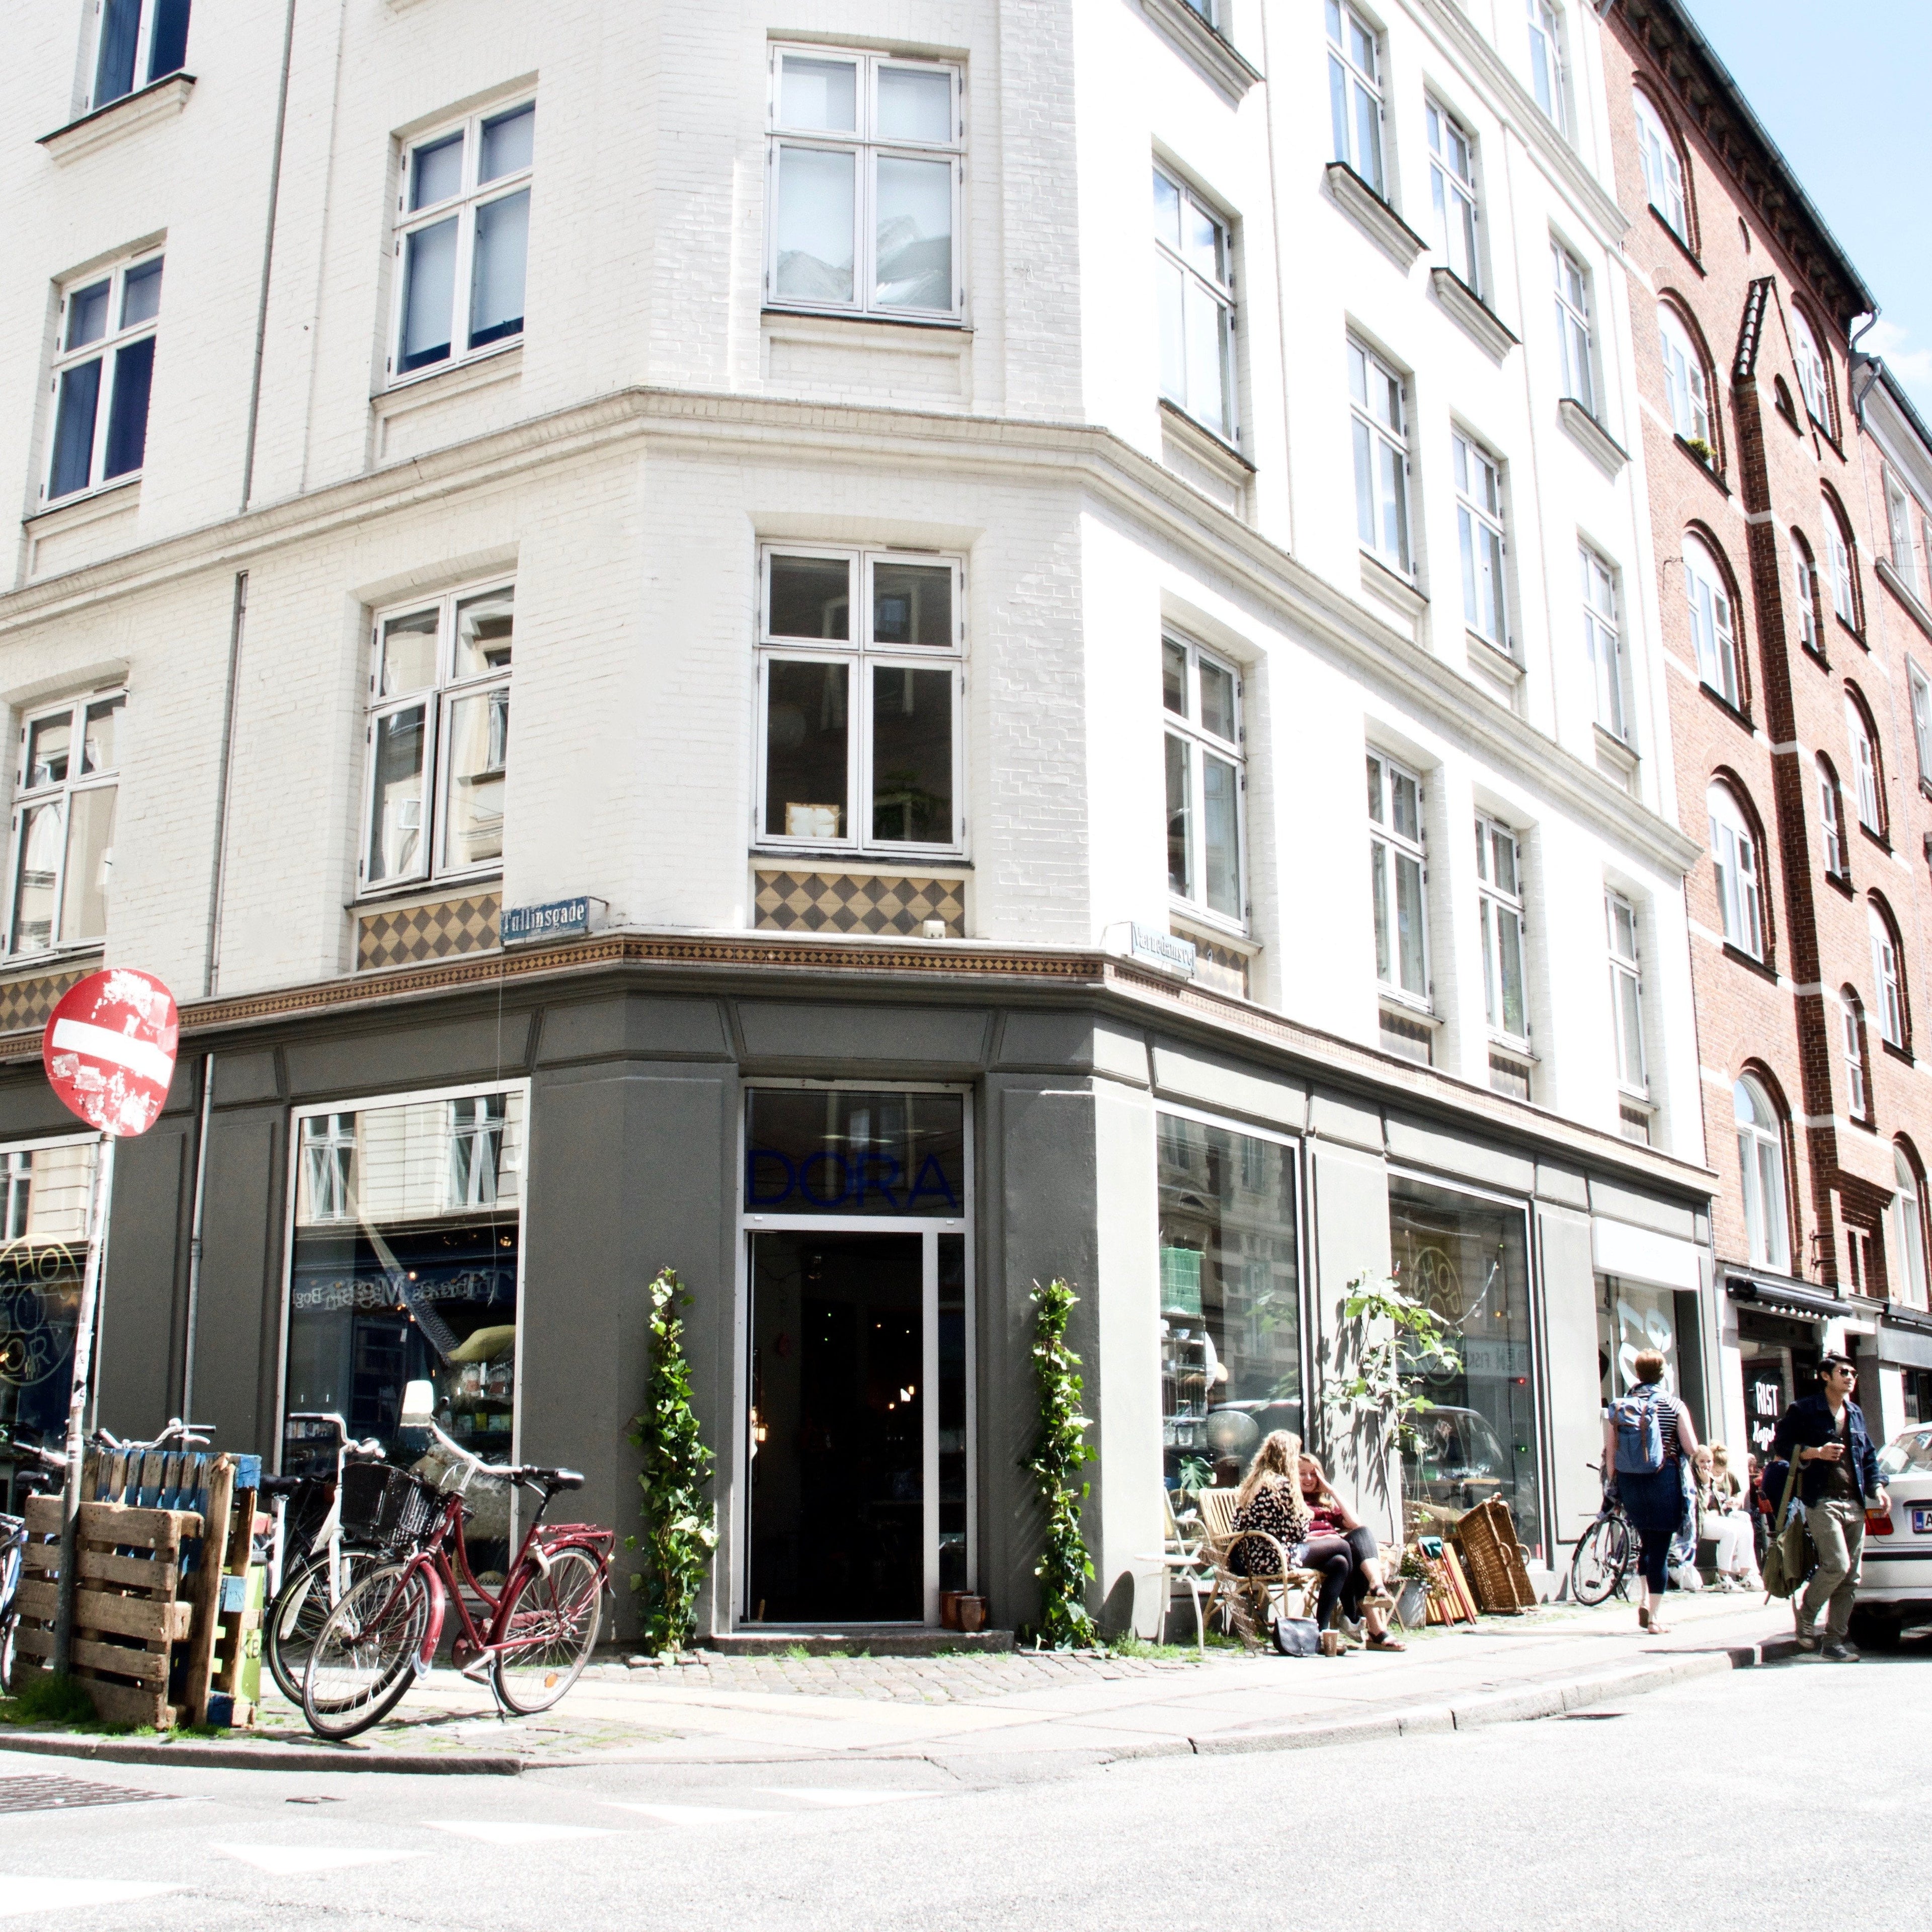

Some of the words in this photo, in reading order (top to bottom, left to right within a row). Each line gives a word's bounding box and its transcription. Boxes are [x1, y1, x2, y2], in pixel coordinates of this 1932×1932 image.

[503, 902, 584, 934] Tullinsgade
[748, 1149, 957, 1207] DORA
[1756, 1382, 1778, 1416] RIST
